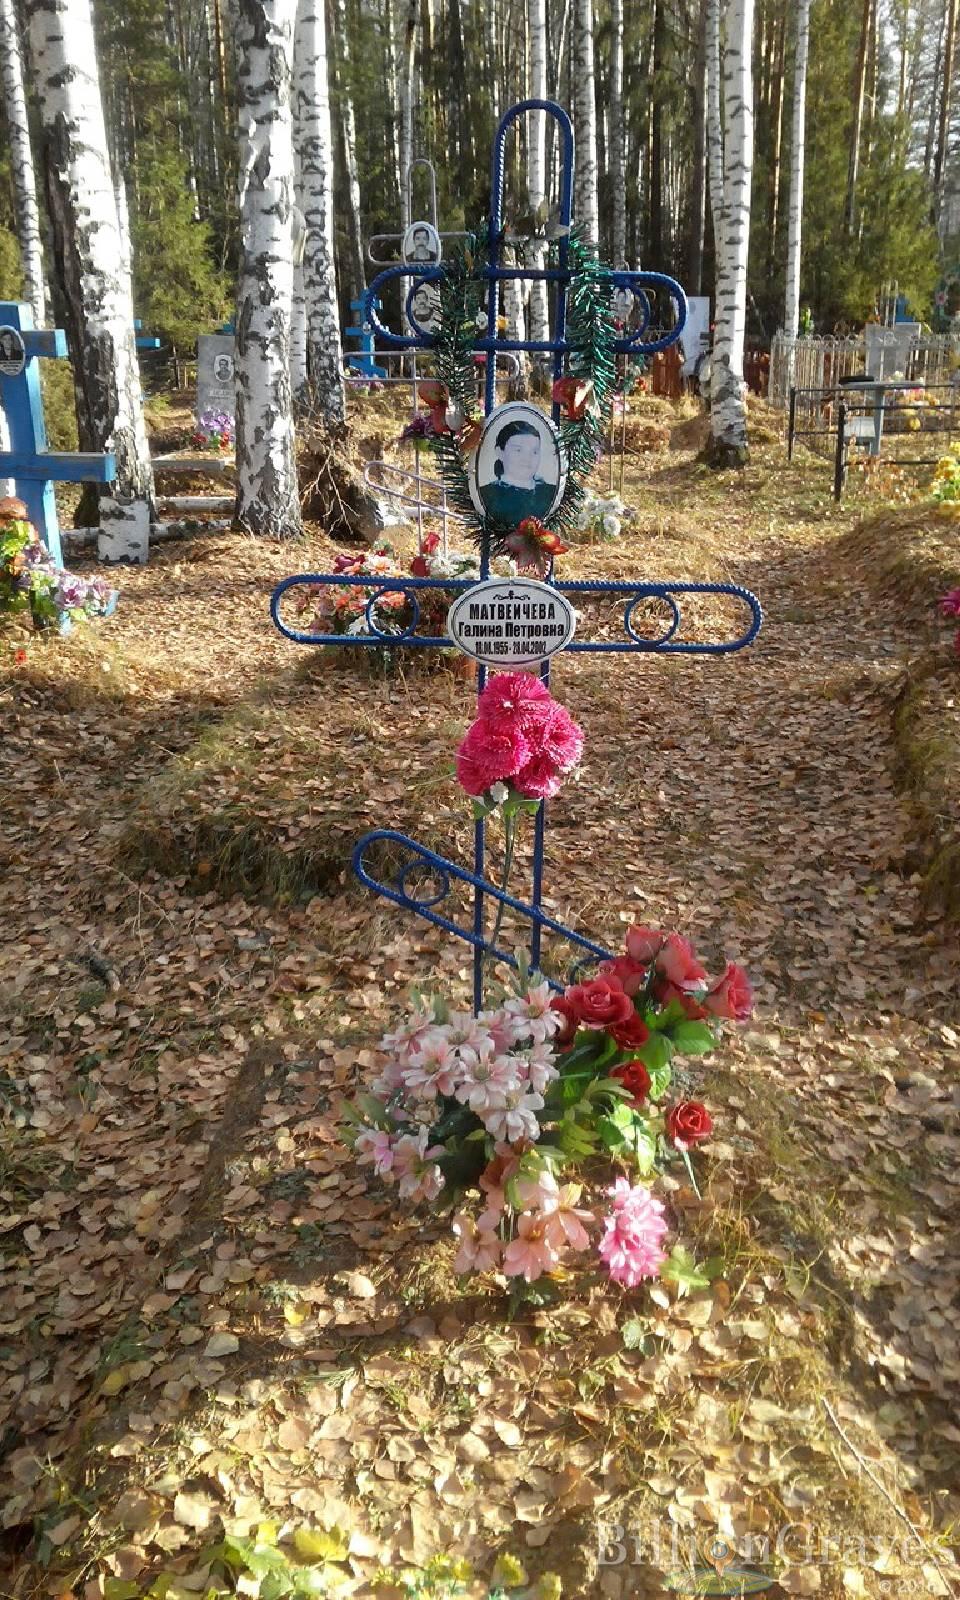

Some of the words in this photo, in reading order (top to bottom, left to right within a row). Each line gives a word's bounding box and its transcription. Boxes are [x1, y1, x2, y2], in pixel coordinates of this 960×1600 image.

[469, 603, 556, 620] МАТВЕИЧЕВА
[458, 622, 503, 637] Галина
[505, 622, 565, 639] Петровна
